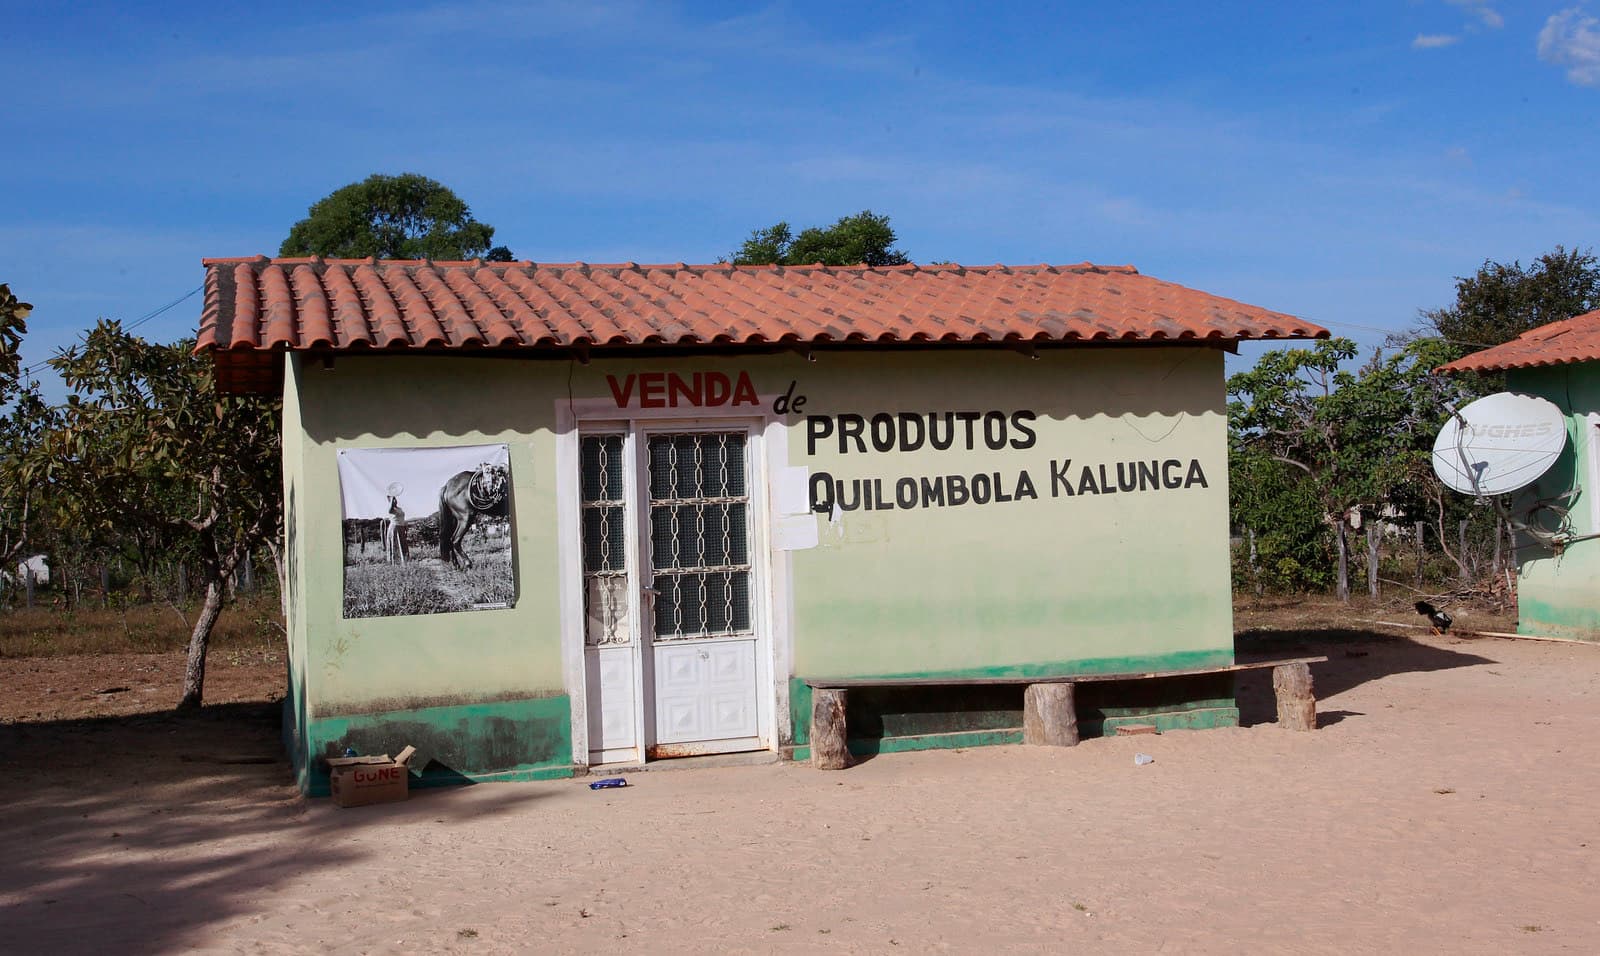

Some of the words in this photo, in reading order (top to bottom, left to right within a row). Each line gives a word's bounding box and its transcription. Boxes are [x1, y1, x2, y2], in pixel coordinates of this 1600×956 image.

[606, 371, 760, 409] VENDA
[773, 380, 808, 415] de
[807, 409, 1037, 456] PRODUTOS
[808, 471, 1038, 522] QUILOMBOLA
[1050, 459, 1208, 498] KALUNGA
